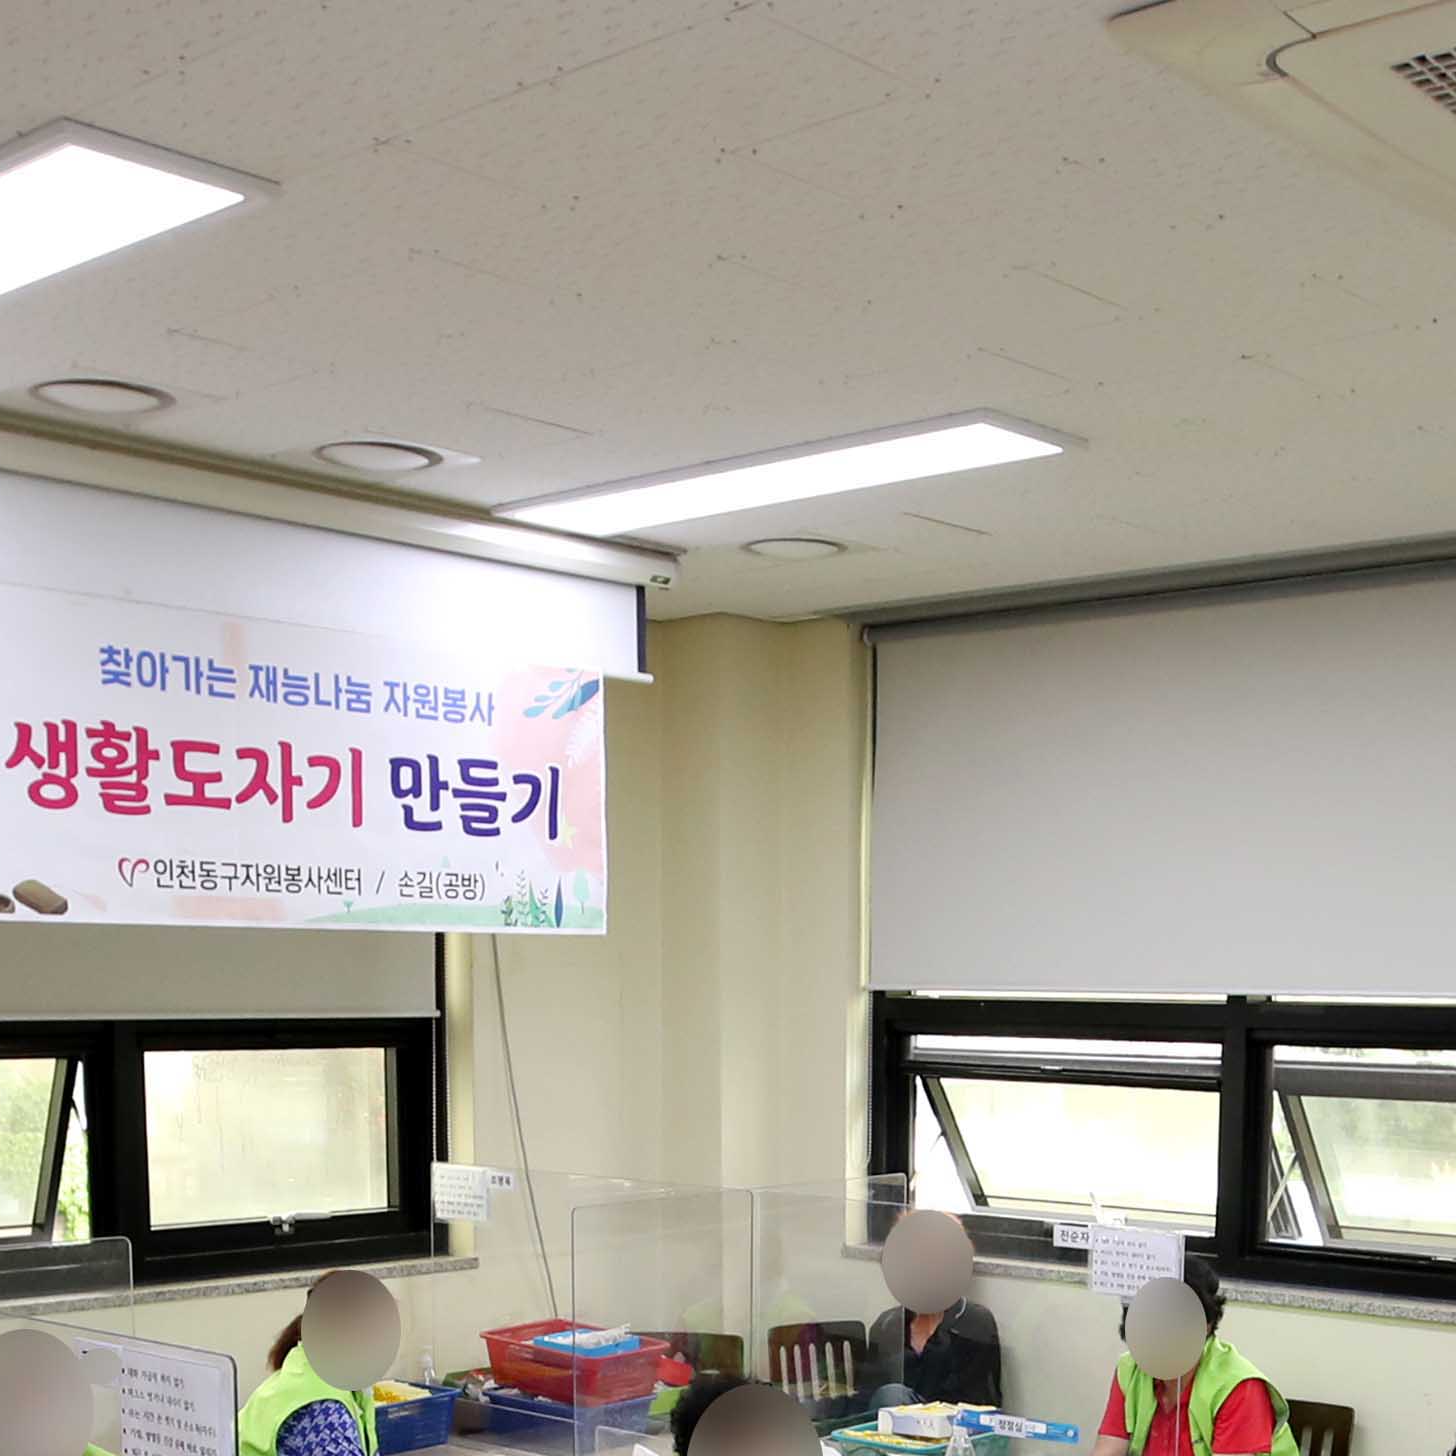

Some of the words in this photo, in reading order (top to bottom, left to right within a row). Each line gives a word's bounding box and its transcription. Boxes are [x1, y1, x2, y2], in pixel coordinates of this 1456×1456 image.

[98, 643, 237, 699] 찾아가는
[248, 663, 373, 714] 재능나눔
[382, 679, 495, 727] 자원봉사
[4, 718, 364, 829] 생활도자기
[389, 754, 560, 840] 만들기
[153, 858, 362, 896] 인천동구자원봉사센터
[397, 869, 486, 902] 손길(공방)
